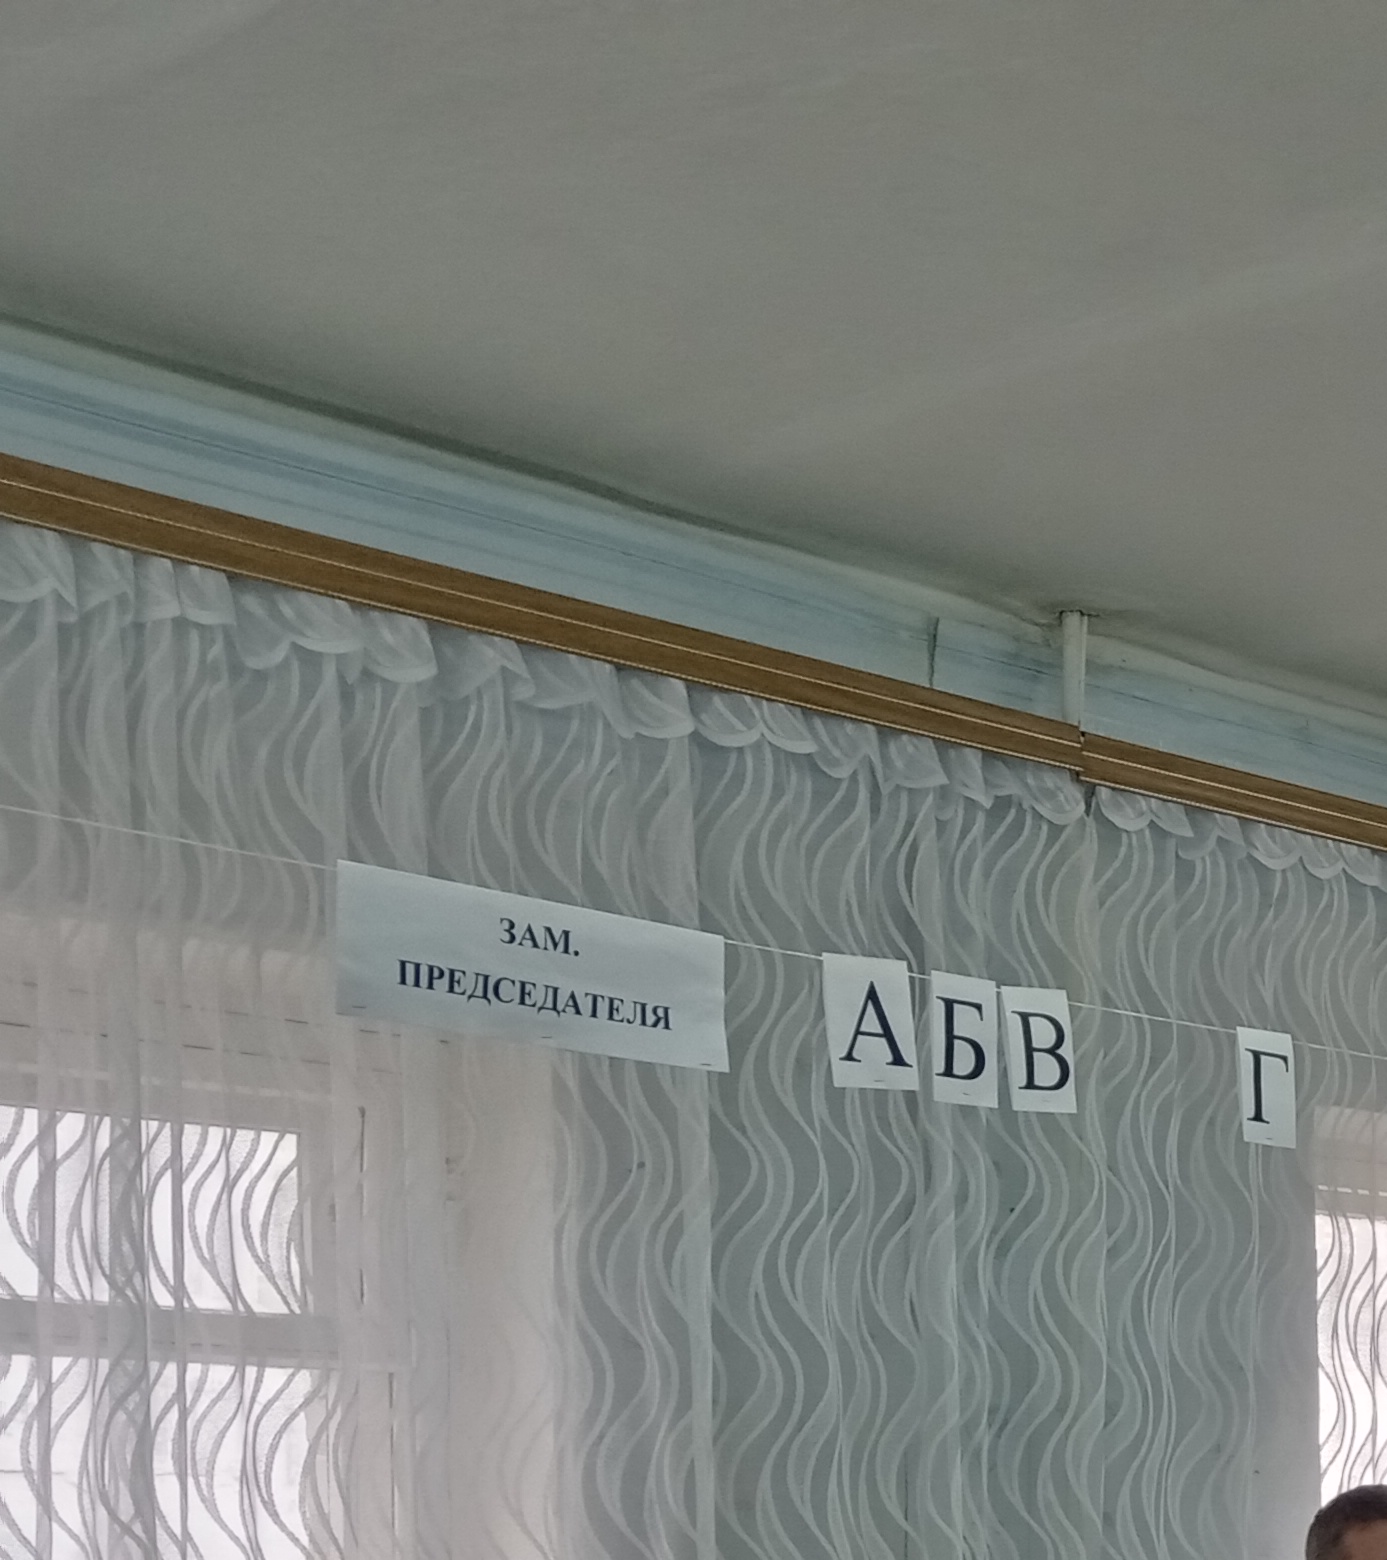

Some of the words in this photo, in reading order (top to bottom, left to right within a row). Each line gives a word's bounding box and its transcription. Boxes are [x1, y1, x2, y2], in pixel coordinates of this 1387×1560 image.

[498, 916, 581, 957] ЗАМ.
[397, 959, 673, 1031] ПРЕДСЕДАТЕЛЯ
[1245, 1047, 1290, 1125] Г
